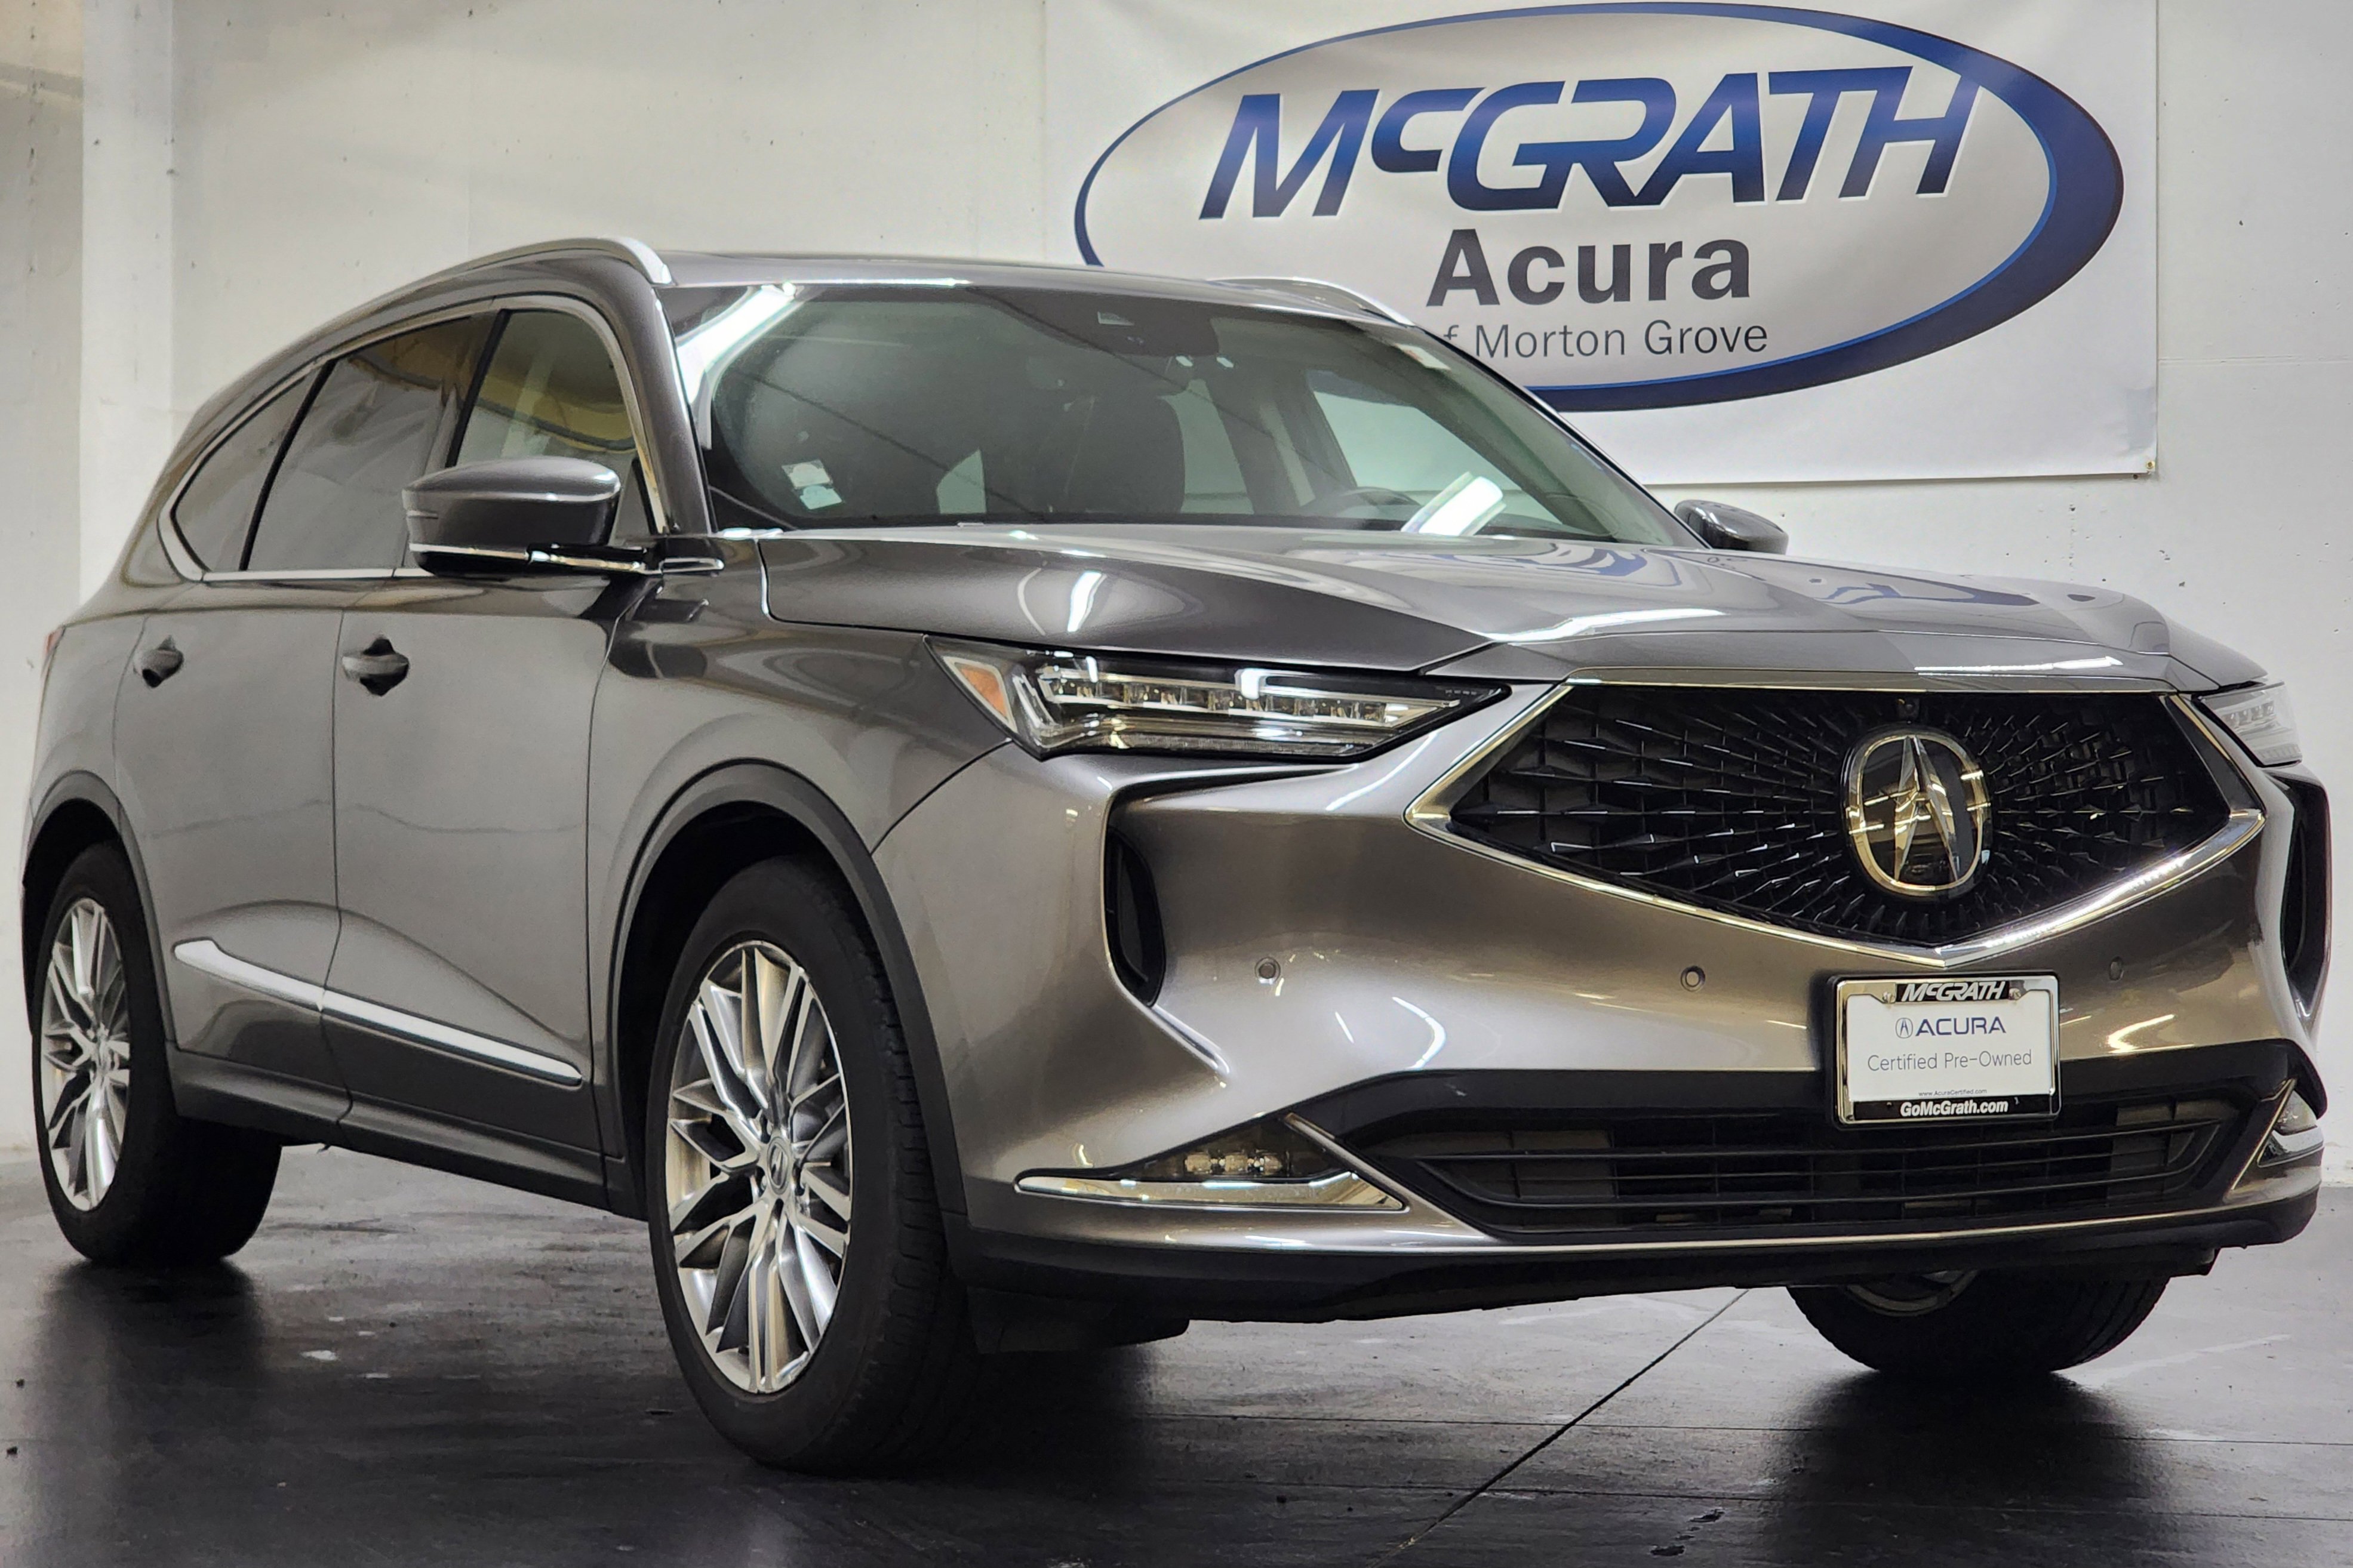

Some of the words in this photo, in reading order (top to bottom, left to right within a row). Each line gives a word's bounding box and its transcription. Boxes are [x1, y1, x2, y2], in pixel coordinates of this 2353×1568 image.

[1426, 228, 1751, 308] Acura
[1476, 324, 1625, 358] Morton
[1643, 319, 1768, 356] Grove
[1915, 1016, 2007, 1036] ACURA
[1868, 1053, 1937, 1071] Certified
[1945, 1049, 2032, 1068] Pre-Owned
[1900, 1099, 2008, 1117] GoMcGrath.com
